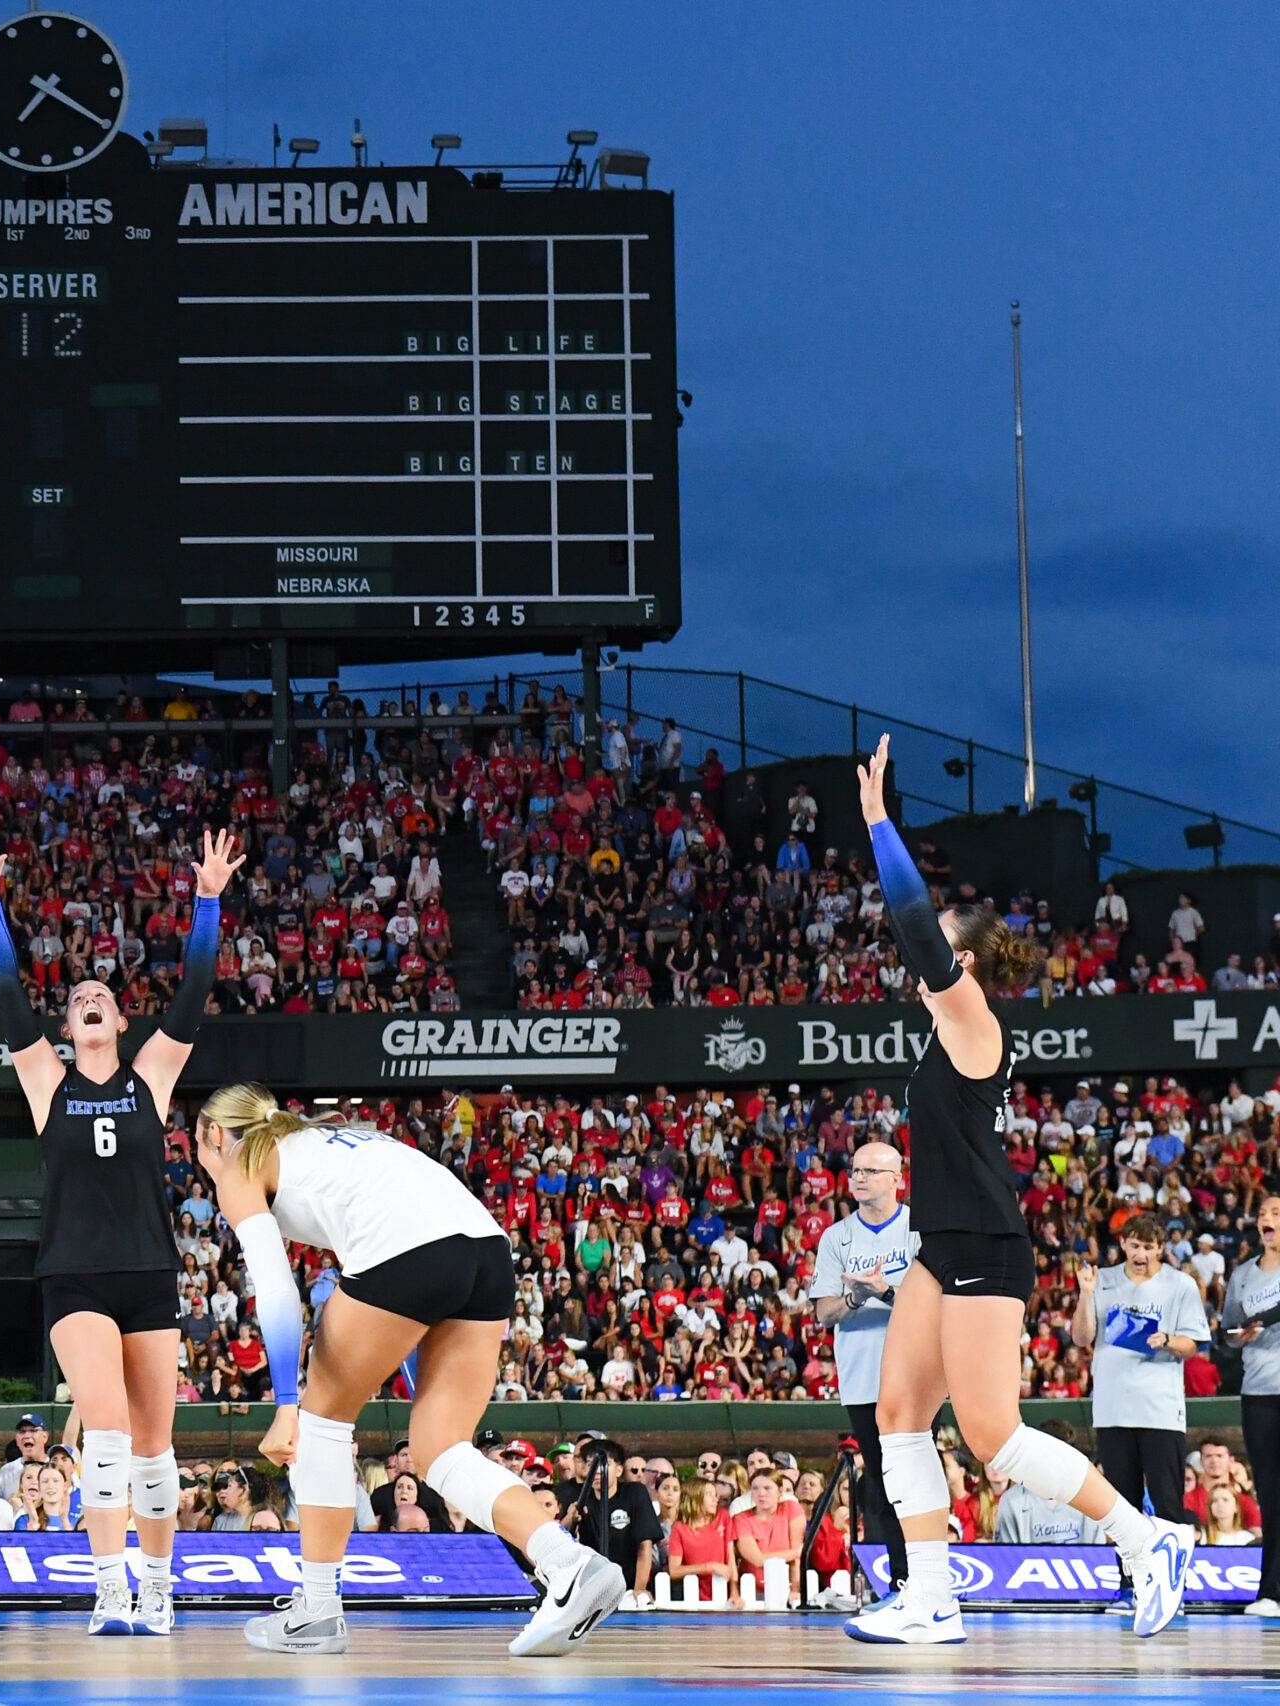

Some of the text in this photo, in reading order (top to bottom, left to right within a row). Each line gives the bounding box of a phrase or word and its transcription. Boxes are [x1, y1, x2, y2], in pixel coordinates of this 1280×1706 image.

[178, 181, 428, 226] AMERICAN
[6, 227, 25, 242] 1ST
[64, 226, 90, 241] 2ND
[125, 225, 151, 241] 3RD
[22, 312, 82, 357] 12
[407, 335, 595, 353] BIG LIFE
[409, 394, 621, 413] BIG STAGE
[410, 455, 572, 473] BIG TEN
[32, 488, 64, 503] SET
[276, 547, 358, 563] MISSOURI
[277, 577, 371, 594] NEBRASKA
[413, 603, 654, 627] 1 2 3 4 5 F
[381, 1017, 621, 1056] GRAINGER
[66, 1095, 137, 1115] KENTUCKY
[93, 1117, 117, 1157] 6
